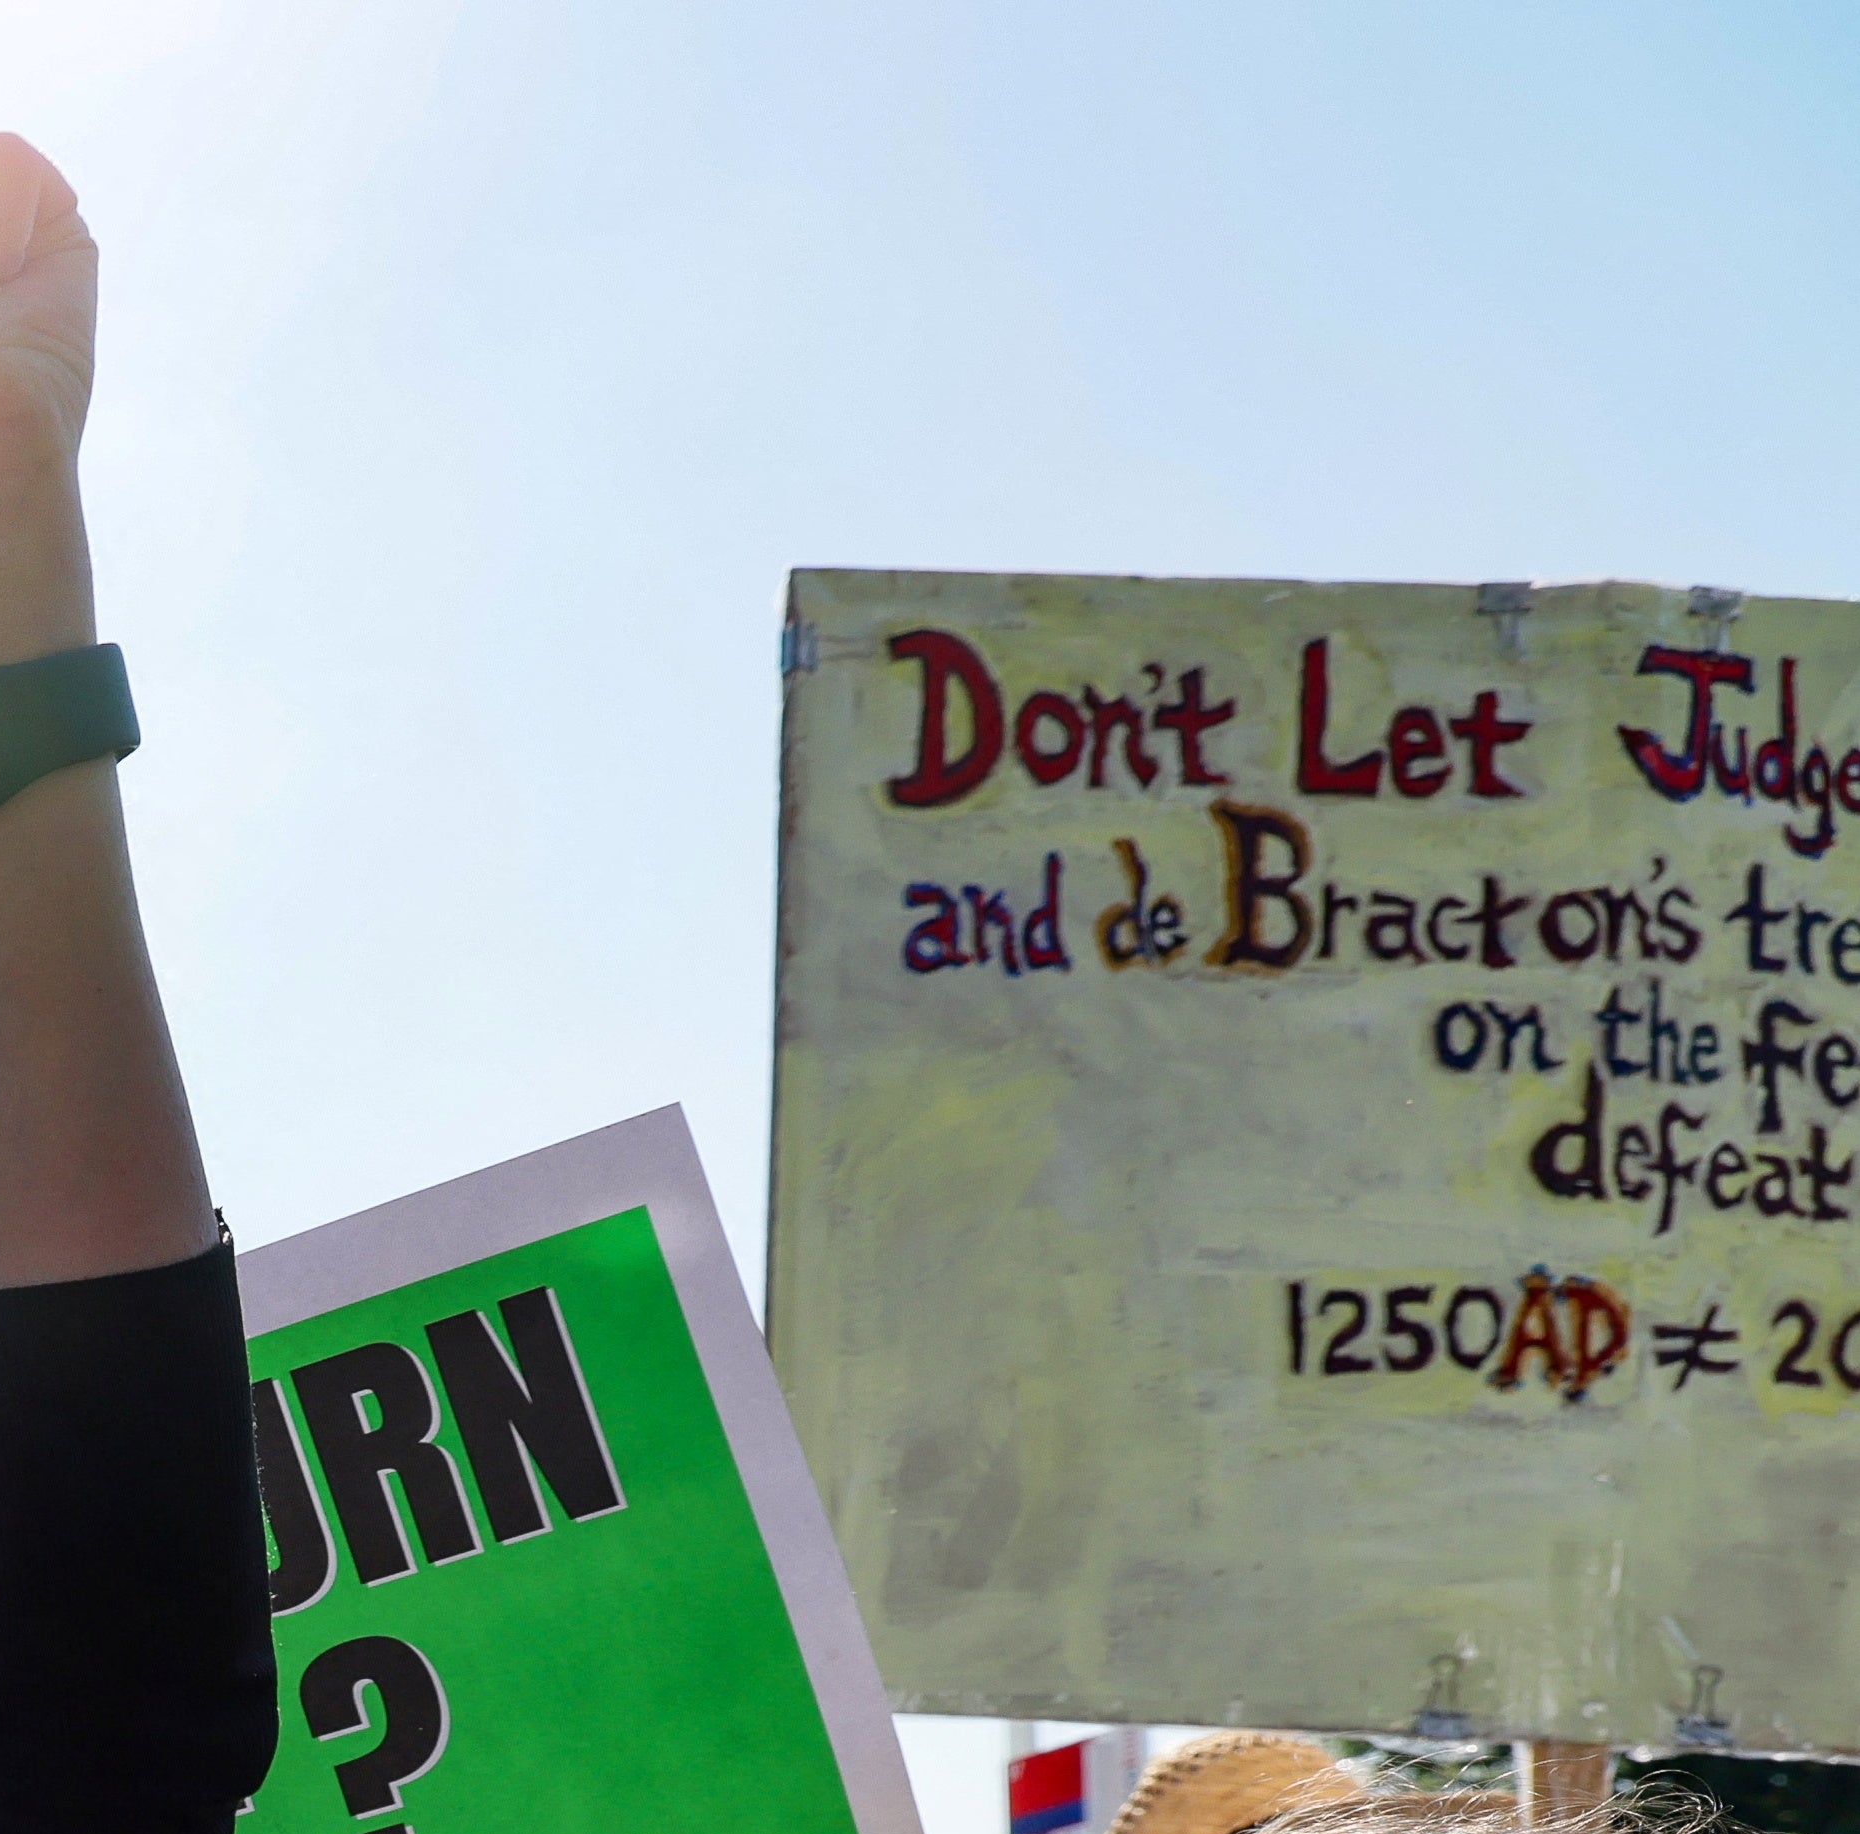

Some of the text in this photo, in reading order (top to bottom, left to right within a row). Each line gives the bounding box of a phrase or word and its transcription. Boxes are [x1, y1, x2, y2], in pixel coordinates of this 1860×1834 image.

[884, 629, 1236, 808] Don't
[1294, 636, 1533, 799] Let
[902, 852, 1071, 976] and
[1095, 837, 1187, 972] de
[1208, 799, 1703, 974] Bracton's
[1432, 1000, 1566, 1074] on
[1594, 976, 1721, 1084] the
[1529, 1066, 1855, 1237] defeat
